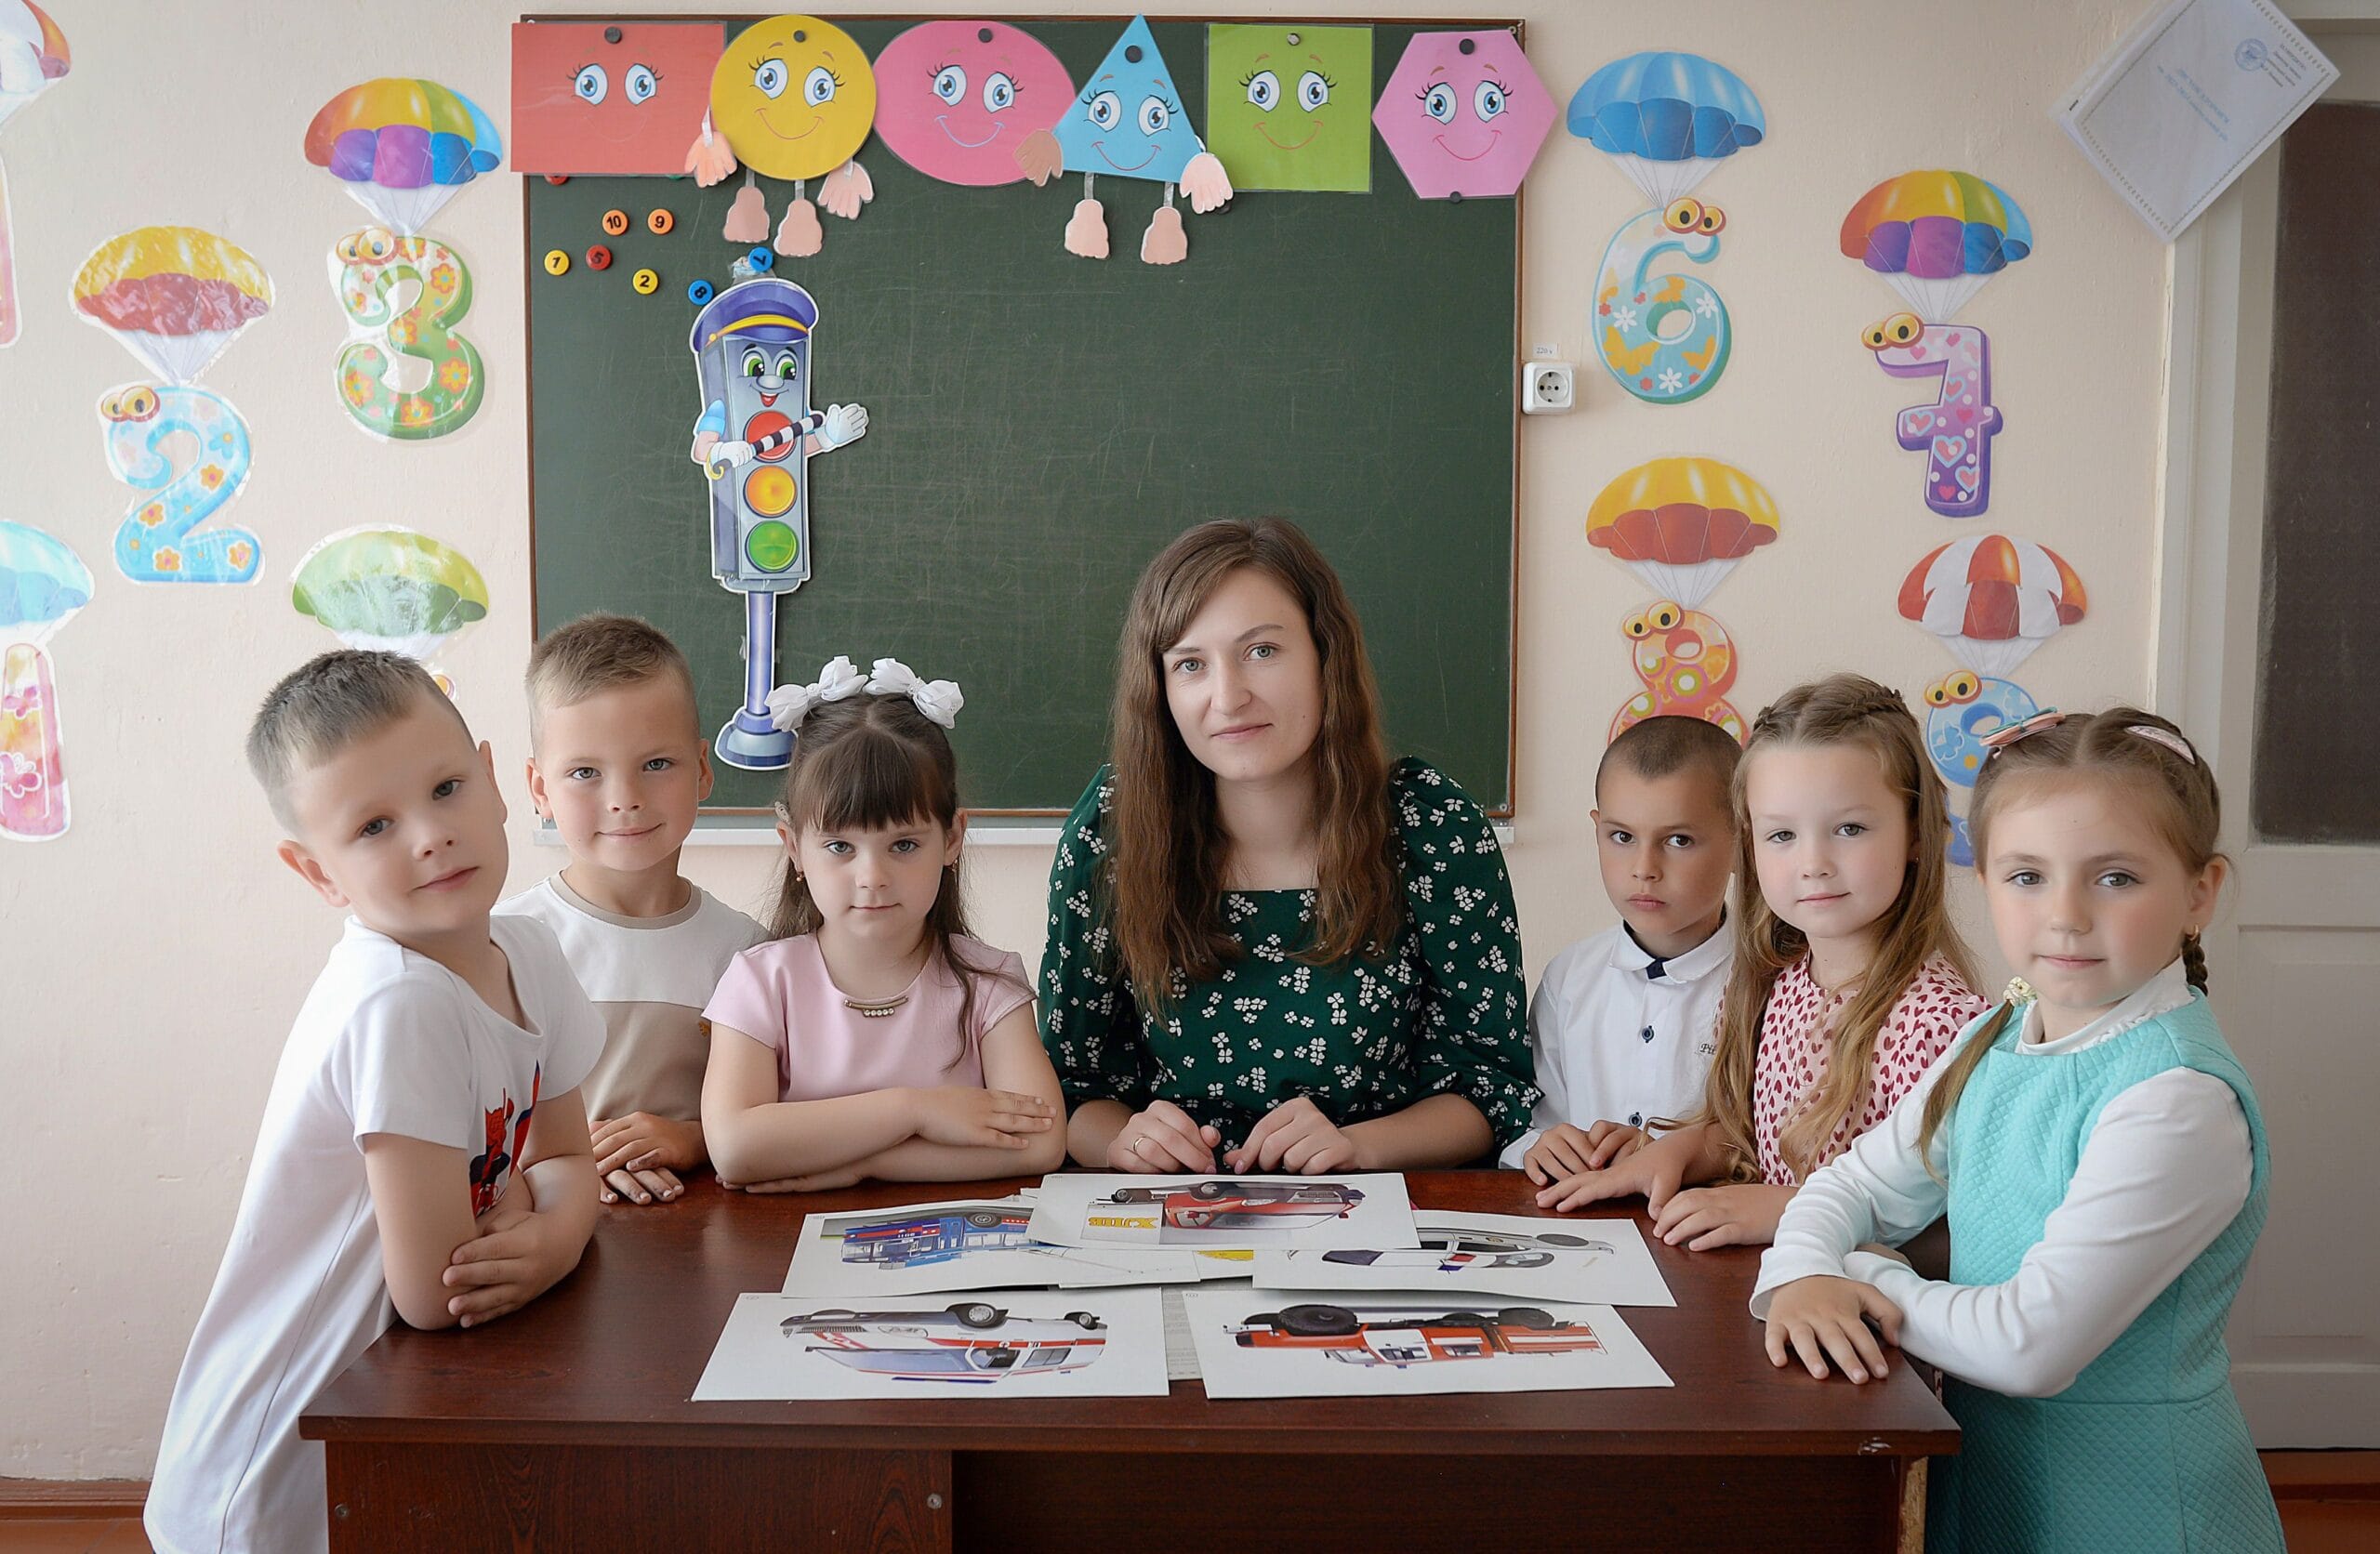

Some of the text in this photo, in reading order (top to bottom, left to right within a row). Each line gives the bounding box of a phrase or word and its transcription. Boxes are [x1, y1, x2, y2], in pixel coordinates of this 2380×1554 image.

[606, 215, 622, 230] 10
[654, 215, 665, 229] 9
[552, 257, 562, 269] 1
[591, 251, 604, 265] 5
[640, 274, 650, 288] 2
[694, 285, 707, 299] 8
[1592, 206, 1732, 404] 6
[338, 234, 485, 440] 3
[1871, 323, 2003, 518] 7
[104, 386, 260, 583] 2
